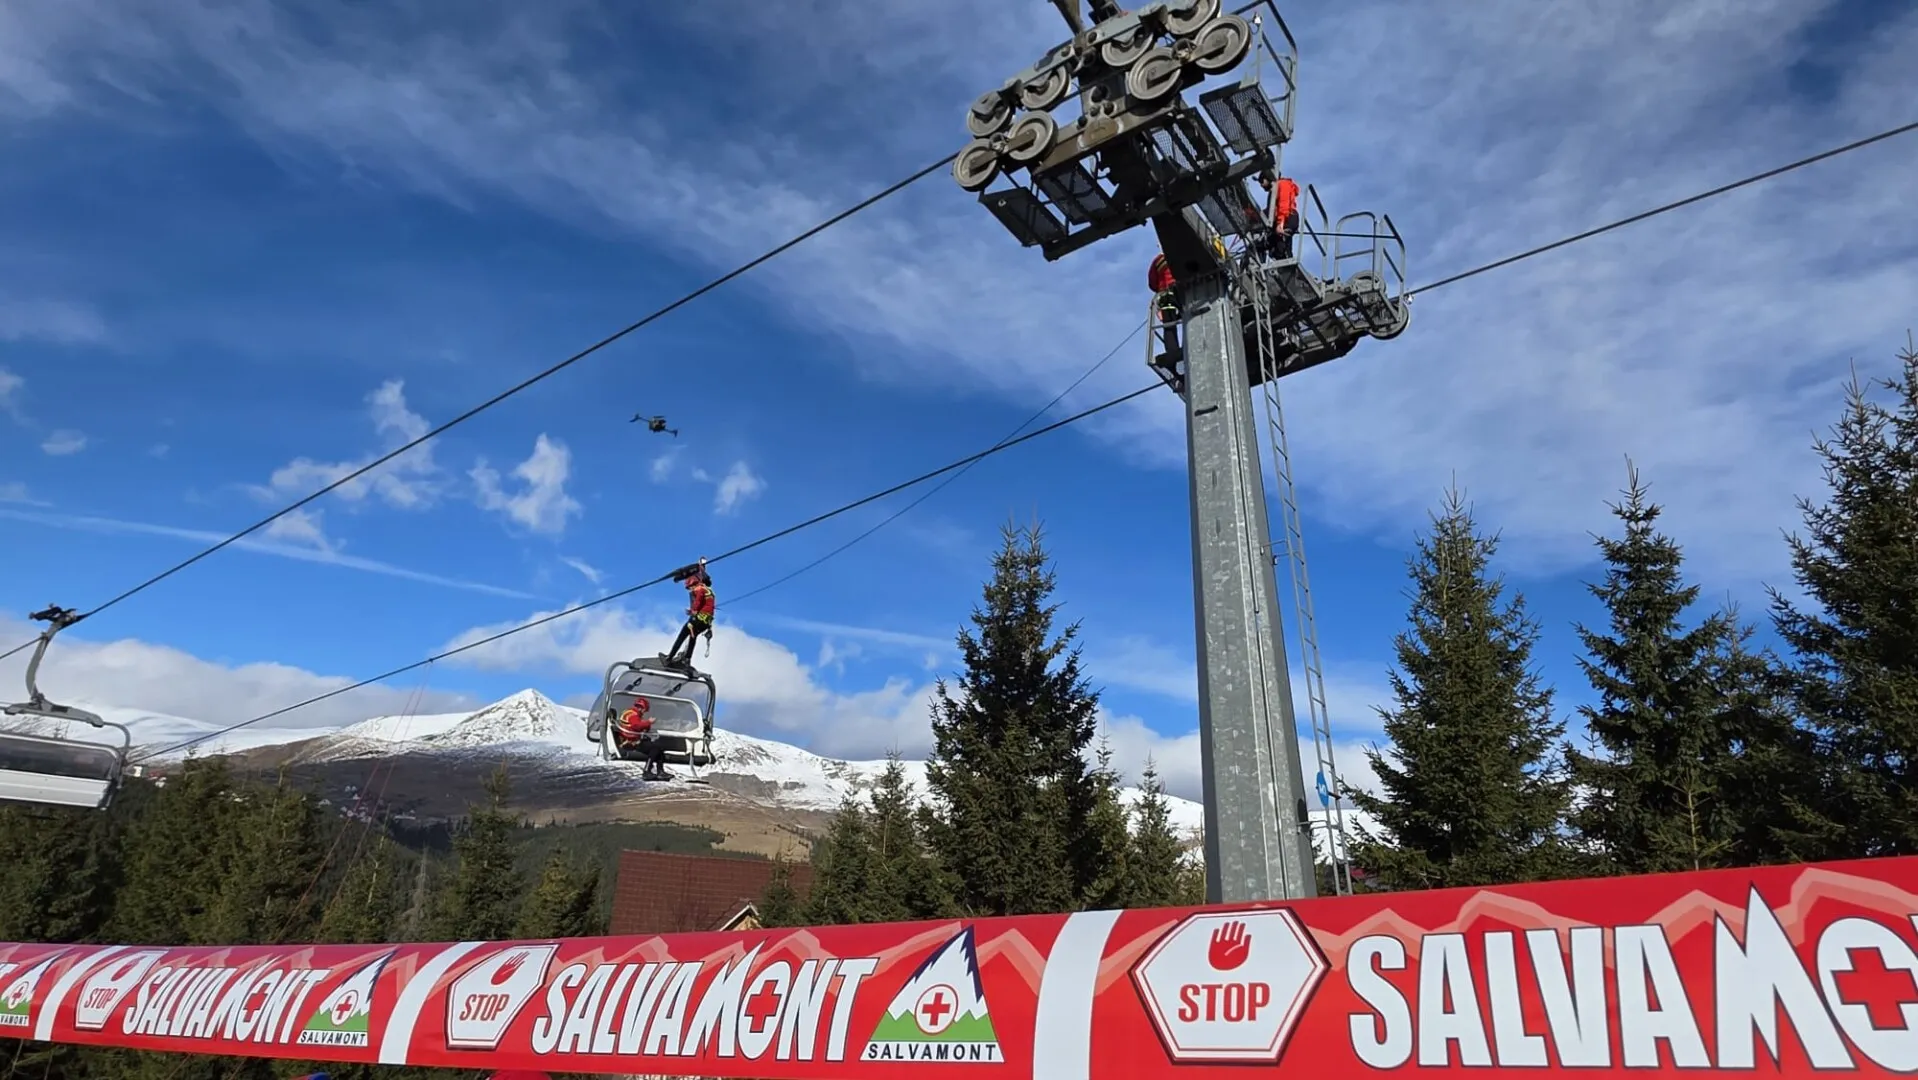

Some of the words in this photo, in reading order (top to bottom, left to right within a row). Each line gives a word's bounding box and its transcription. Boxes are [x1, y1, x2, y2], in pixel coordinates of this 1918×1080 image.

[1347, 882, 1918, 1075] SALVAMO
[84, 988, 118, 1009] STOP
[122, 955, 332, 1045] SALVAMONT
[459, 993, 507, 1022] STOP
[531, 938, 880, 1063] SALVAMONT
[1178, 983, 1270, 1023] STOP
[0, 1015, 28, 1025] VAMONT
[301, 1032, 365, 1045] SALVAMONT
[867, 1042, 1001, 1061] SALVAMONT
